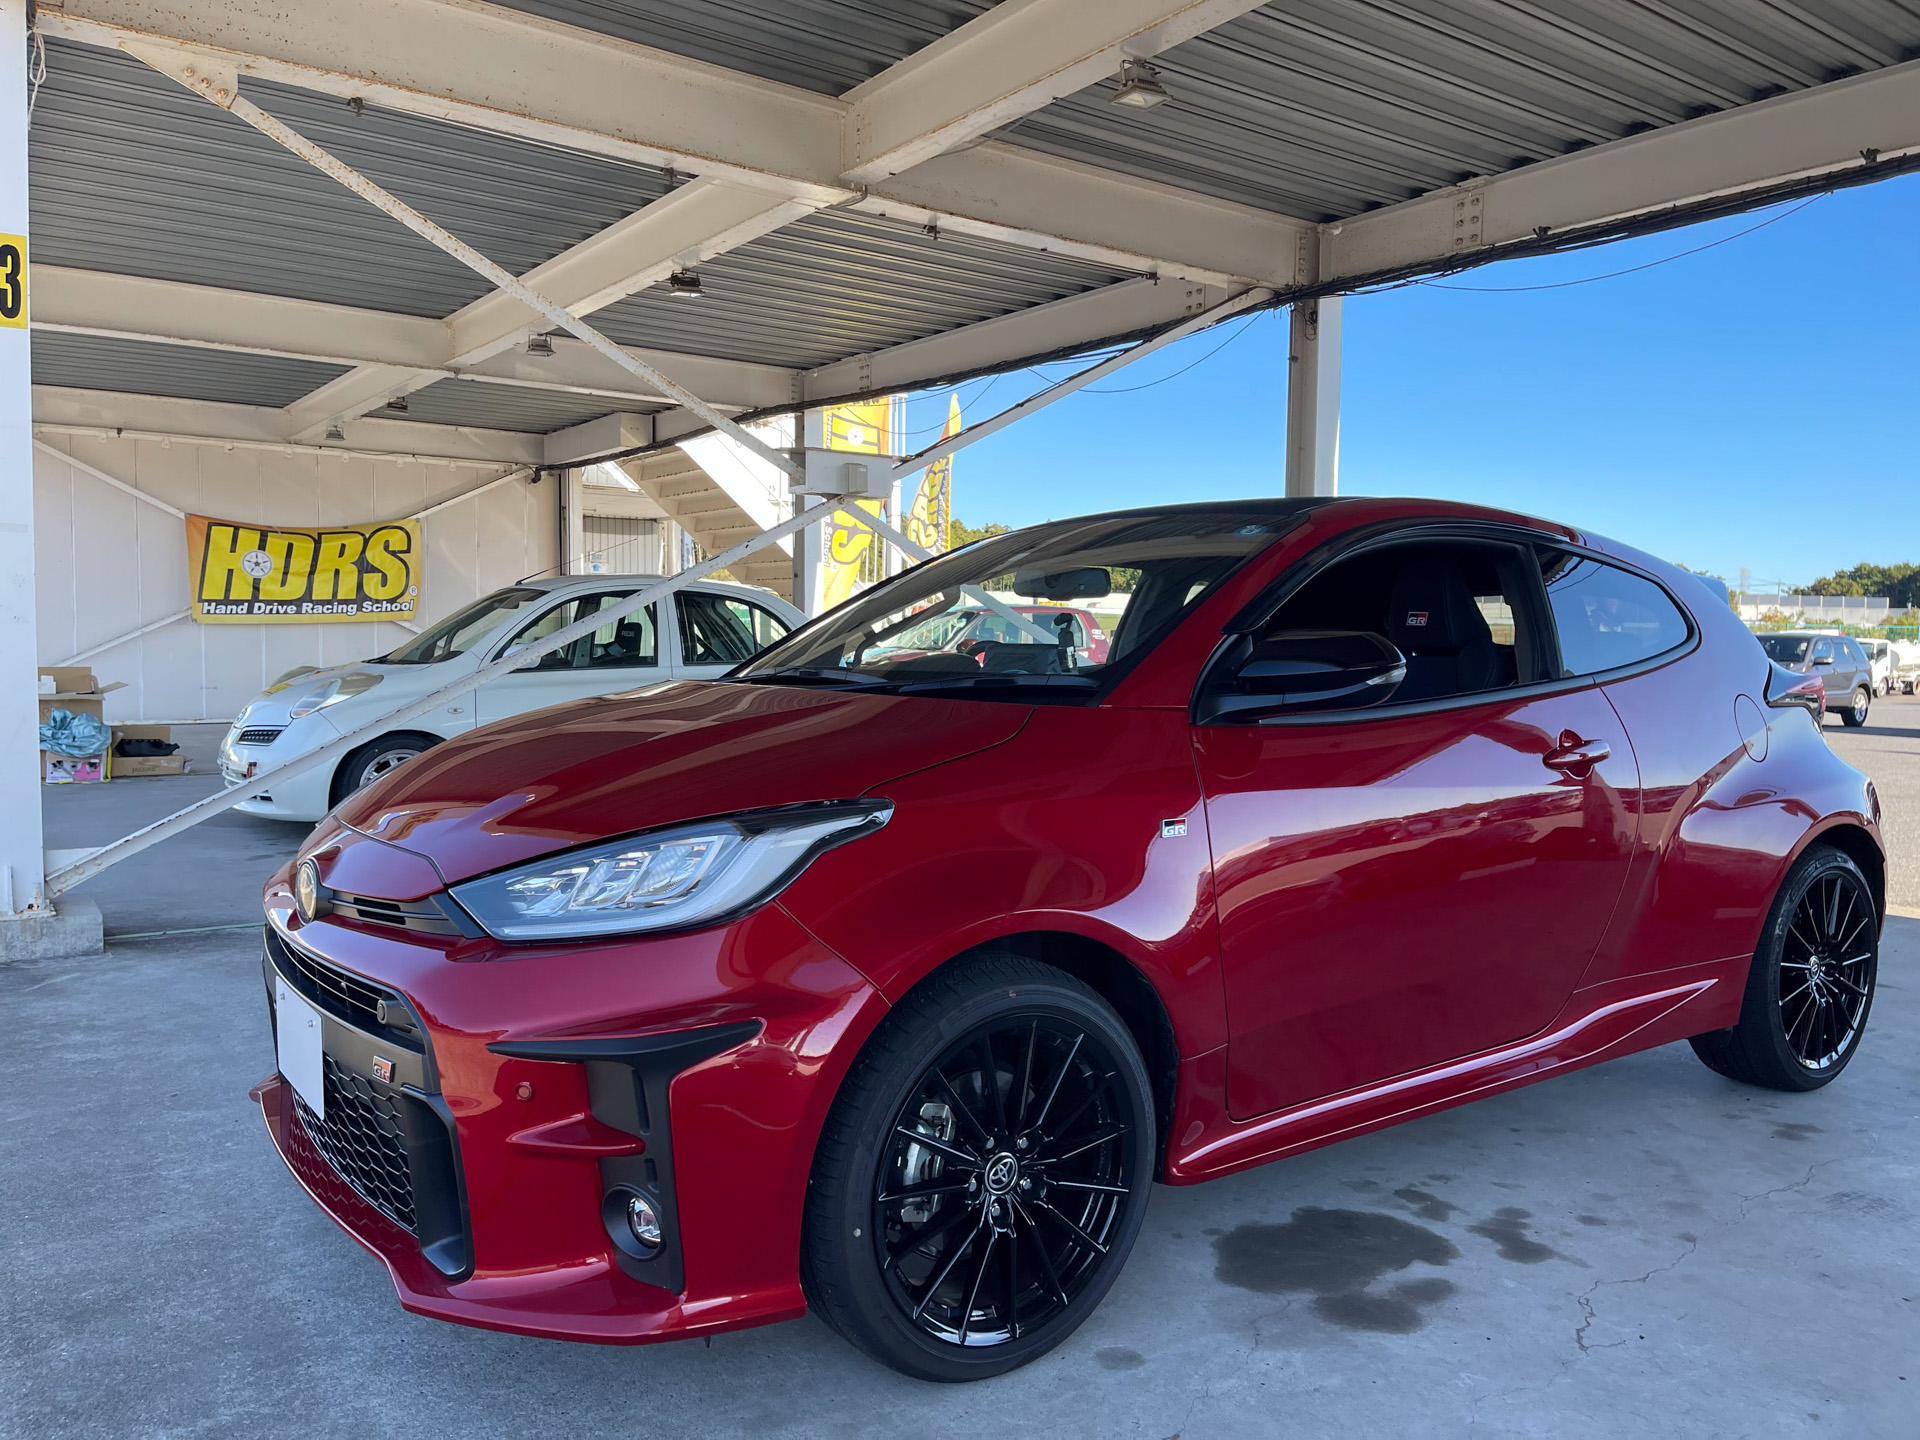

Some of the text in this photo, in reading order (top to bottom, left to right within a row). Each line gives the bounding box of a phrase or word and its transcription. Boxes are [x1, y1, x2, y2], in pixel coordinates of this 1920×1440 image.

[0, 244, 21, 319] 3
[199, 522, 411, 601] HDRS
[202, 600, 414, 616] Hand Drive Racing School
[1407, 616, 1426, 625] GR
[1163, 824, 1186, 836] GR
[373, 1063, 390, 1082] GR
